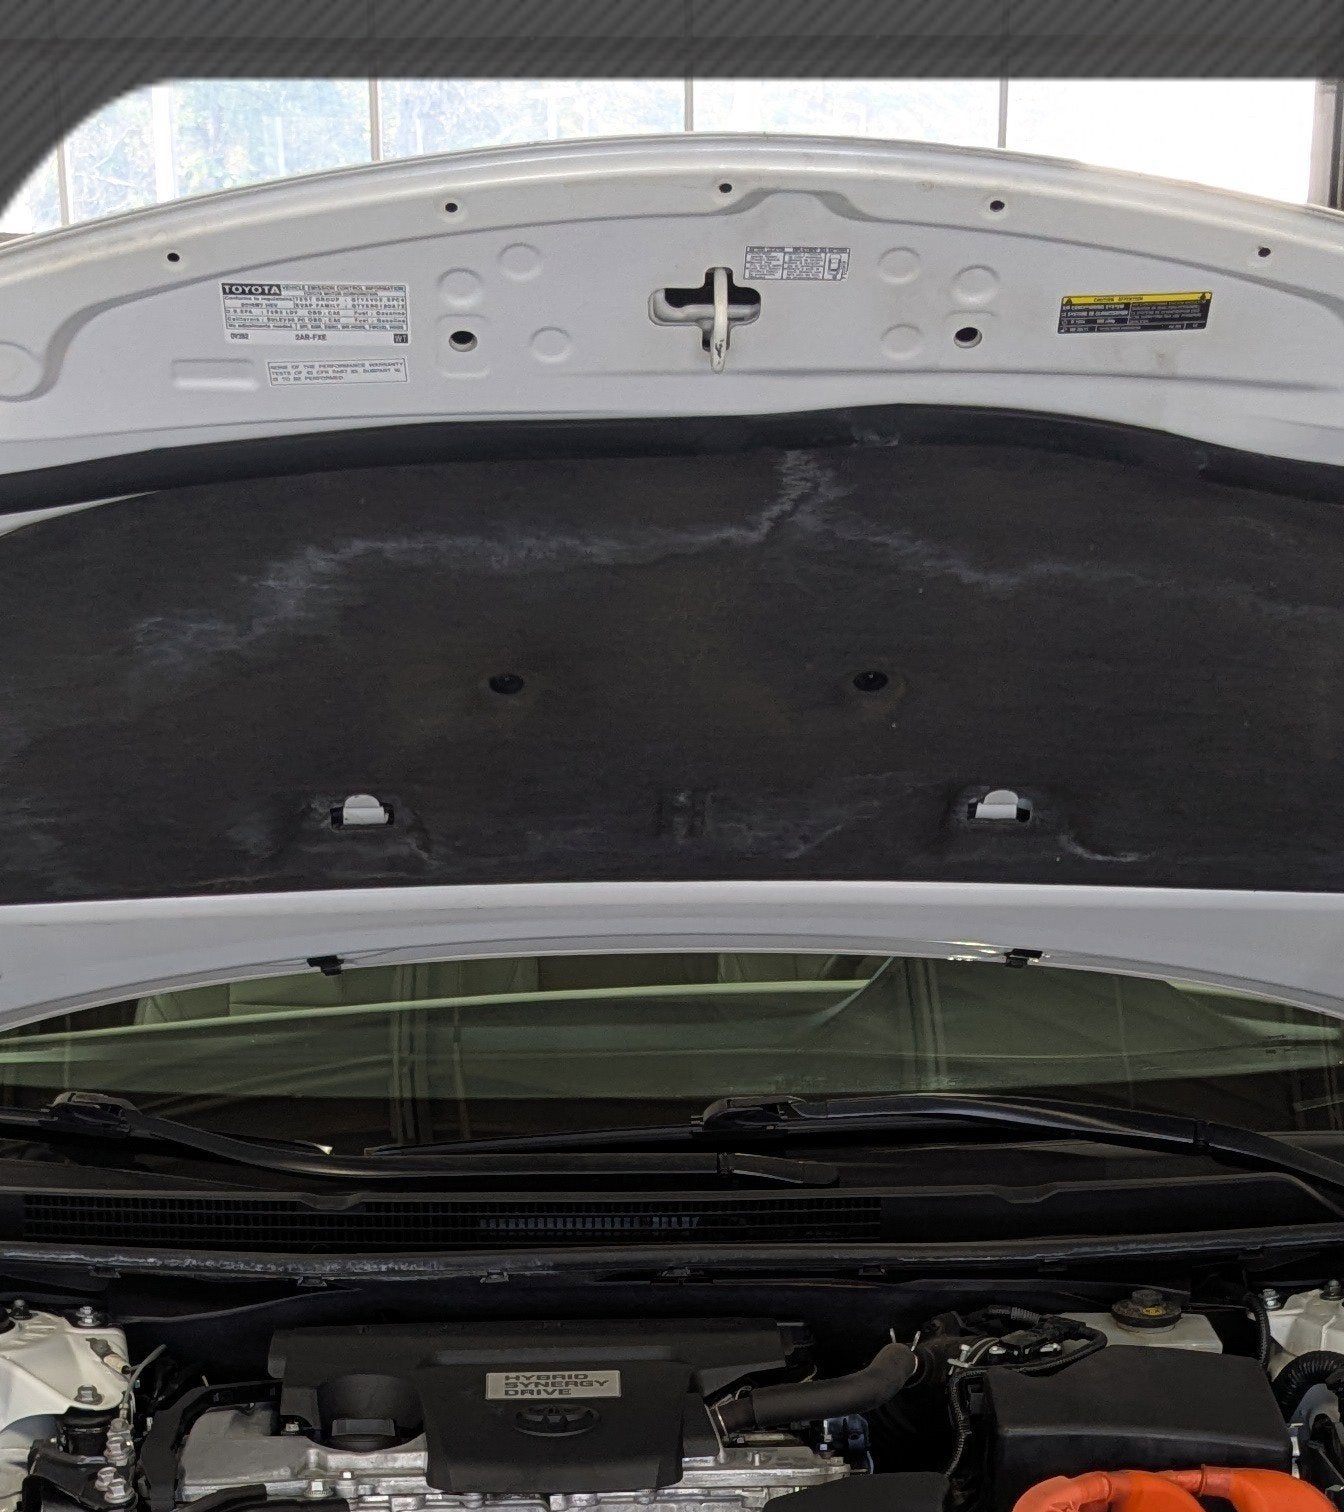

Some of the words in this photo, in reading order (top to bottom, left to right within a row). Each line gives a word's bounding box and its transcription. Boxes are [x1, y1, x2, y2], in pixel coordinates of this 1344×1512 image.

[222, 285, 280, 294] TOYOTA
[504, 1373, 589, 1381] HYBRID
[504, 1380, 609, 1389] SYNERGY
[504, 1388, 571, 1396] DRIVE
